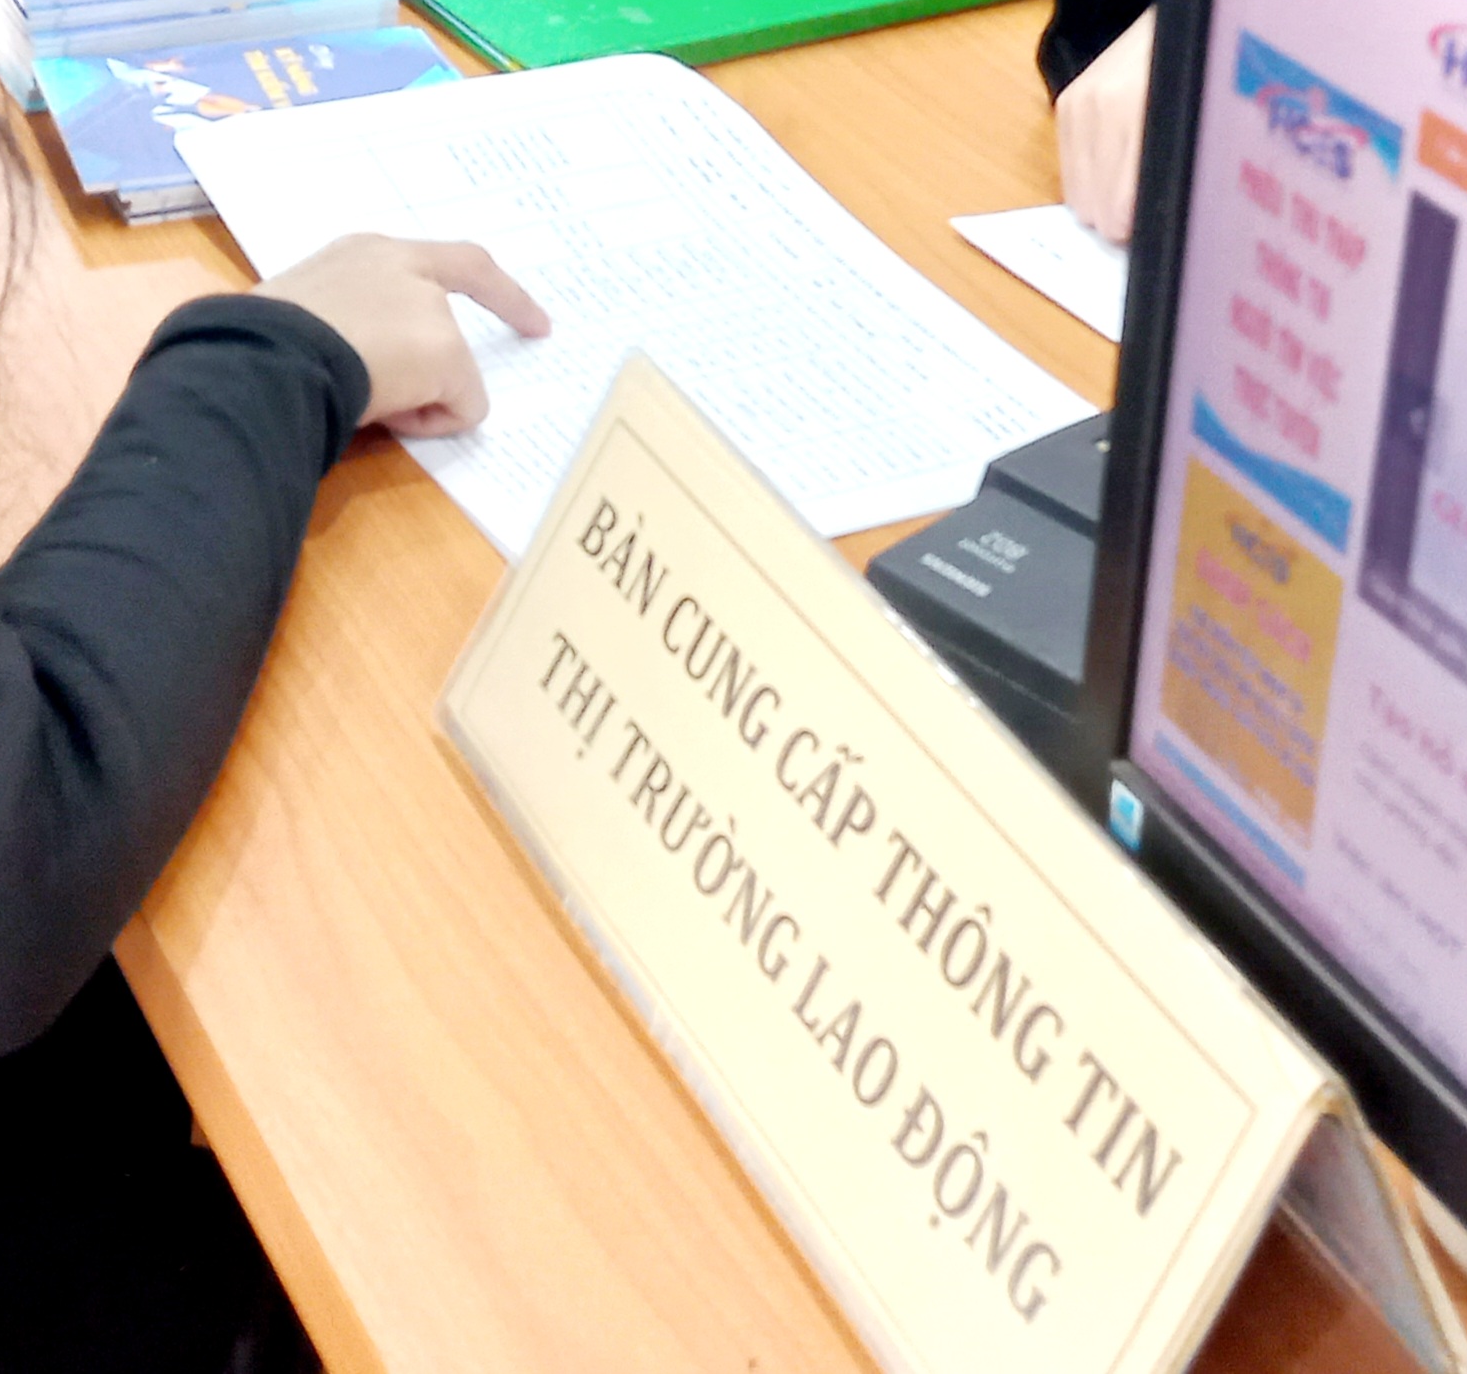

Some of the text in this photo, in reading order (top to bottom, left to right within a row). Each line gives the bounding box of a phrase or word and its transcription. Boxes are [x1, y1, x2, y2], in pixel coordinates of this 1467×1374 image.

[537, 629, 1064, 1325] THỊ TRƯỜNG LAO ĐỘNG
[575, 494, 1184, 1220] BÀN CUNG CẤP THÔNG TIN
